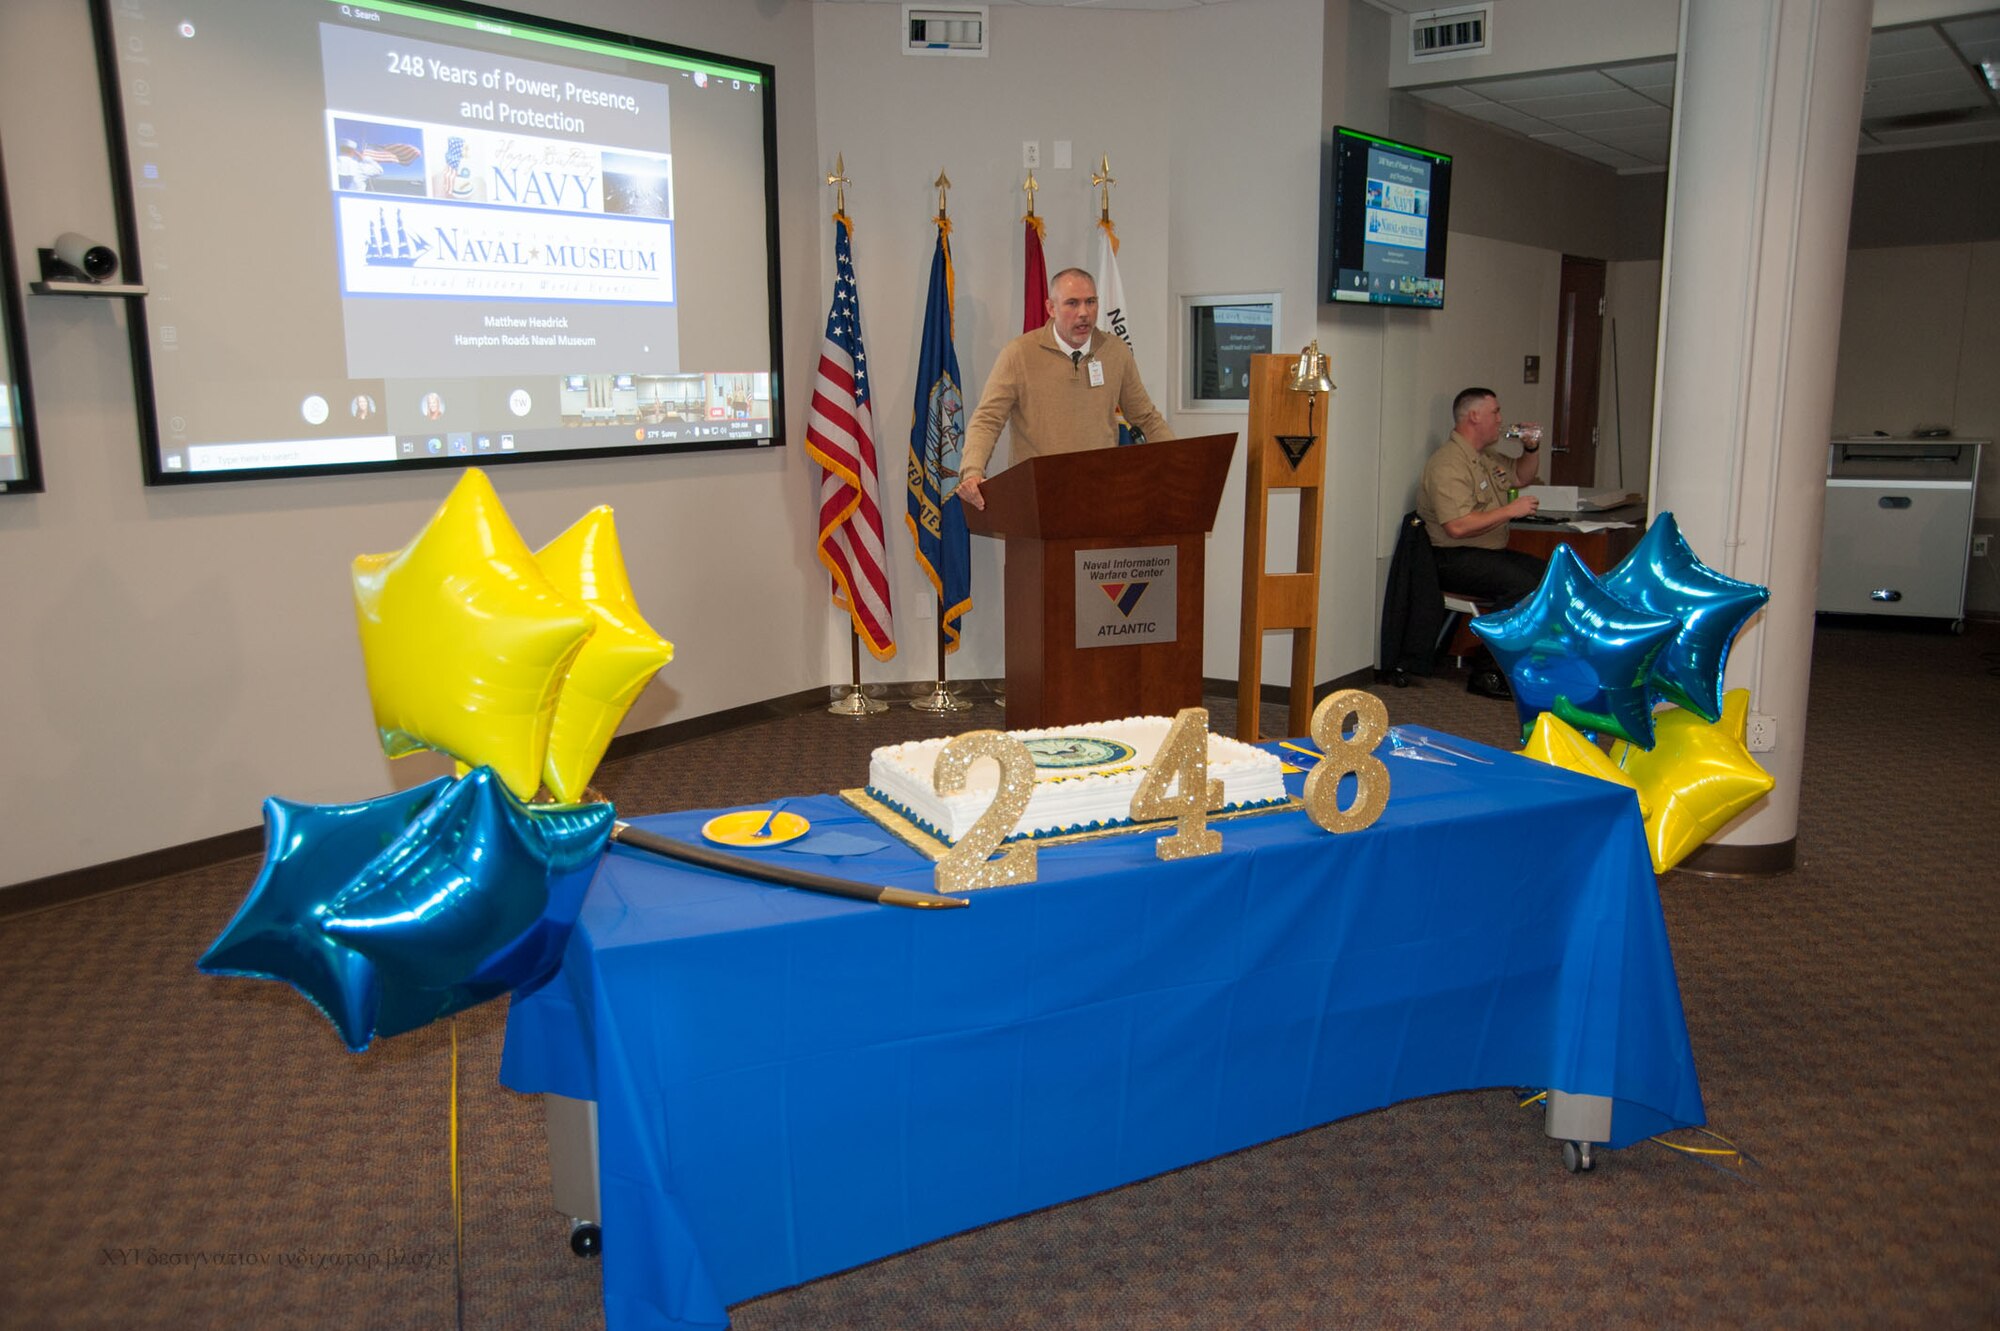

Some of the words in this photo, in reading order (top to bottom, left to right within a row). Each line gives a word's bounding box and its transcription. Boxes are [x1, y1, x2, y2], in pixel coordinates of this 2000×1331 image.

[354, 8, 381, 23] Search
[387, 52, 425, 78] 248
[428, 58, 477, 88] Years
[482, 69, 500, 89] of
[505, 72, 562, 102] Power,
[566, 82, 640, 114] Presence,
[460, 100, 494, 121] and
[499, 103, 585, 134] Protection
[491, 165, 597, 209] NAVY
[434, 226, 528, 265] NAVAL
[545, 244, 658, 272] MUSEUM
[484, 316, 527, 328] Matthew
[529, 316, 569, 328] Headrick
[455, 334, 500, 348] Hampton
[502, 335, 530, 346] Roads
[531, 335, 556, 346] Naval
[558, 335, 596, 346] Museum
[1083, 560, 1111, 571] Naval
[1113, 557, 1170, 568] Information
[1090, 570, 1128, 580] Warfare
[1130, 568, 1164, 578] Center
[1098, 622, 1156, 636] ATLANTIC
[933, 729, 1038, 894] 2
[1130, 706, 1225, 861] 4
[1303, 688, 1391, 835] 8
